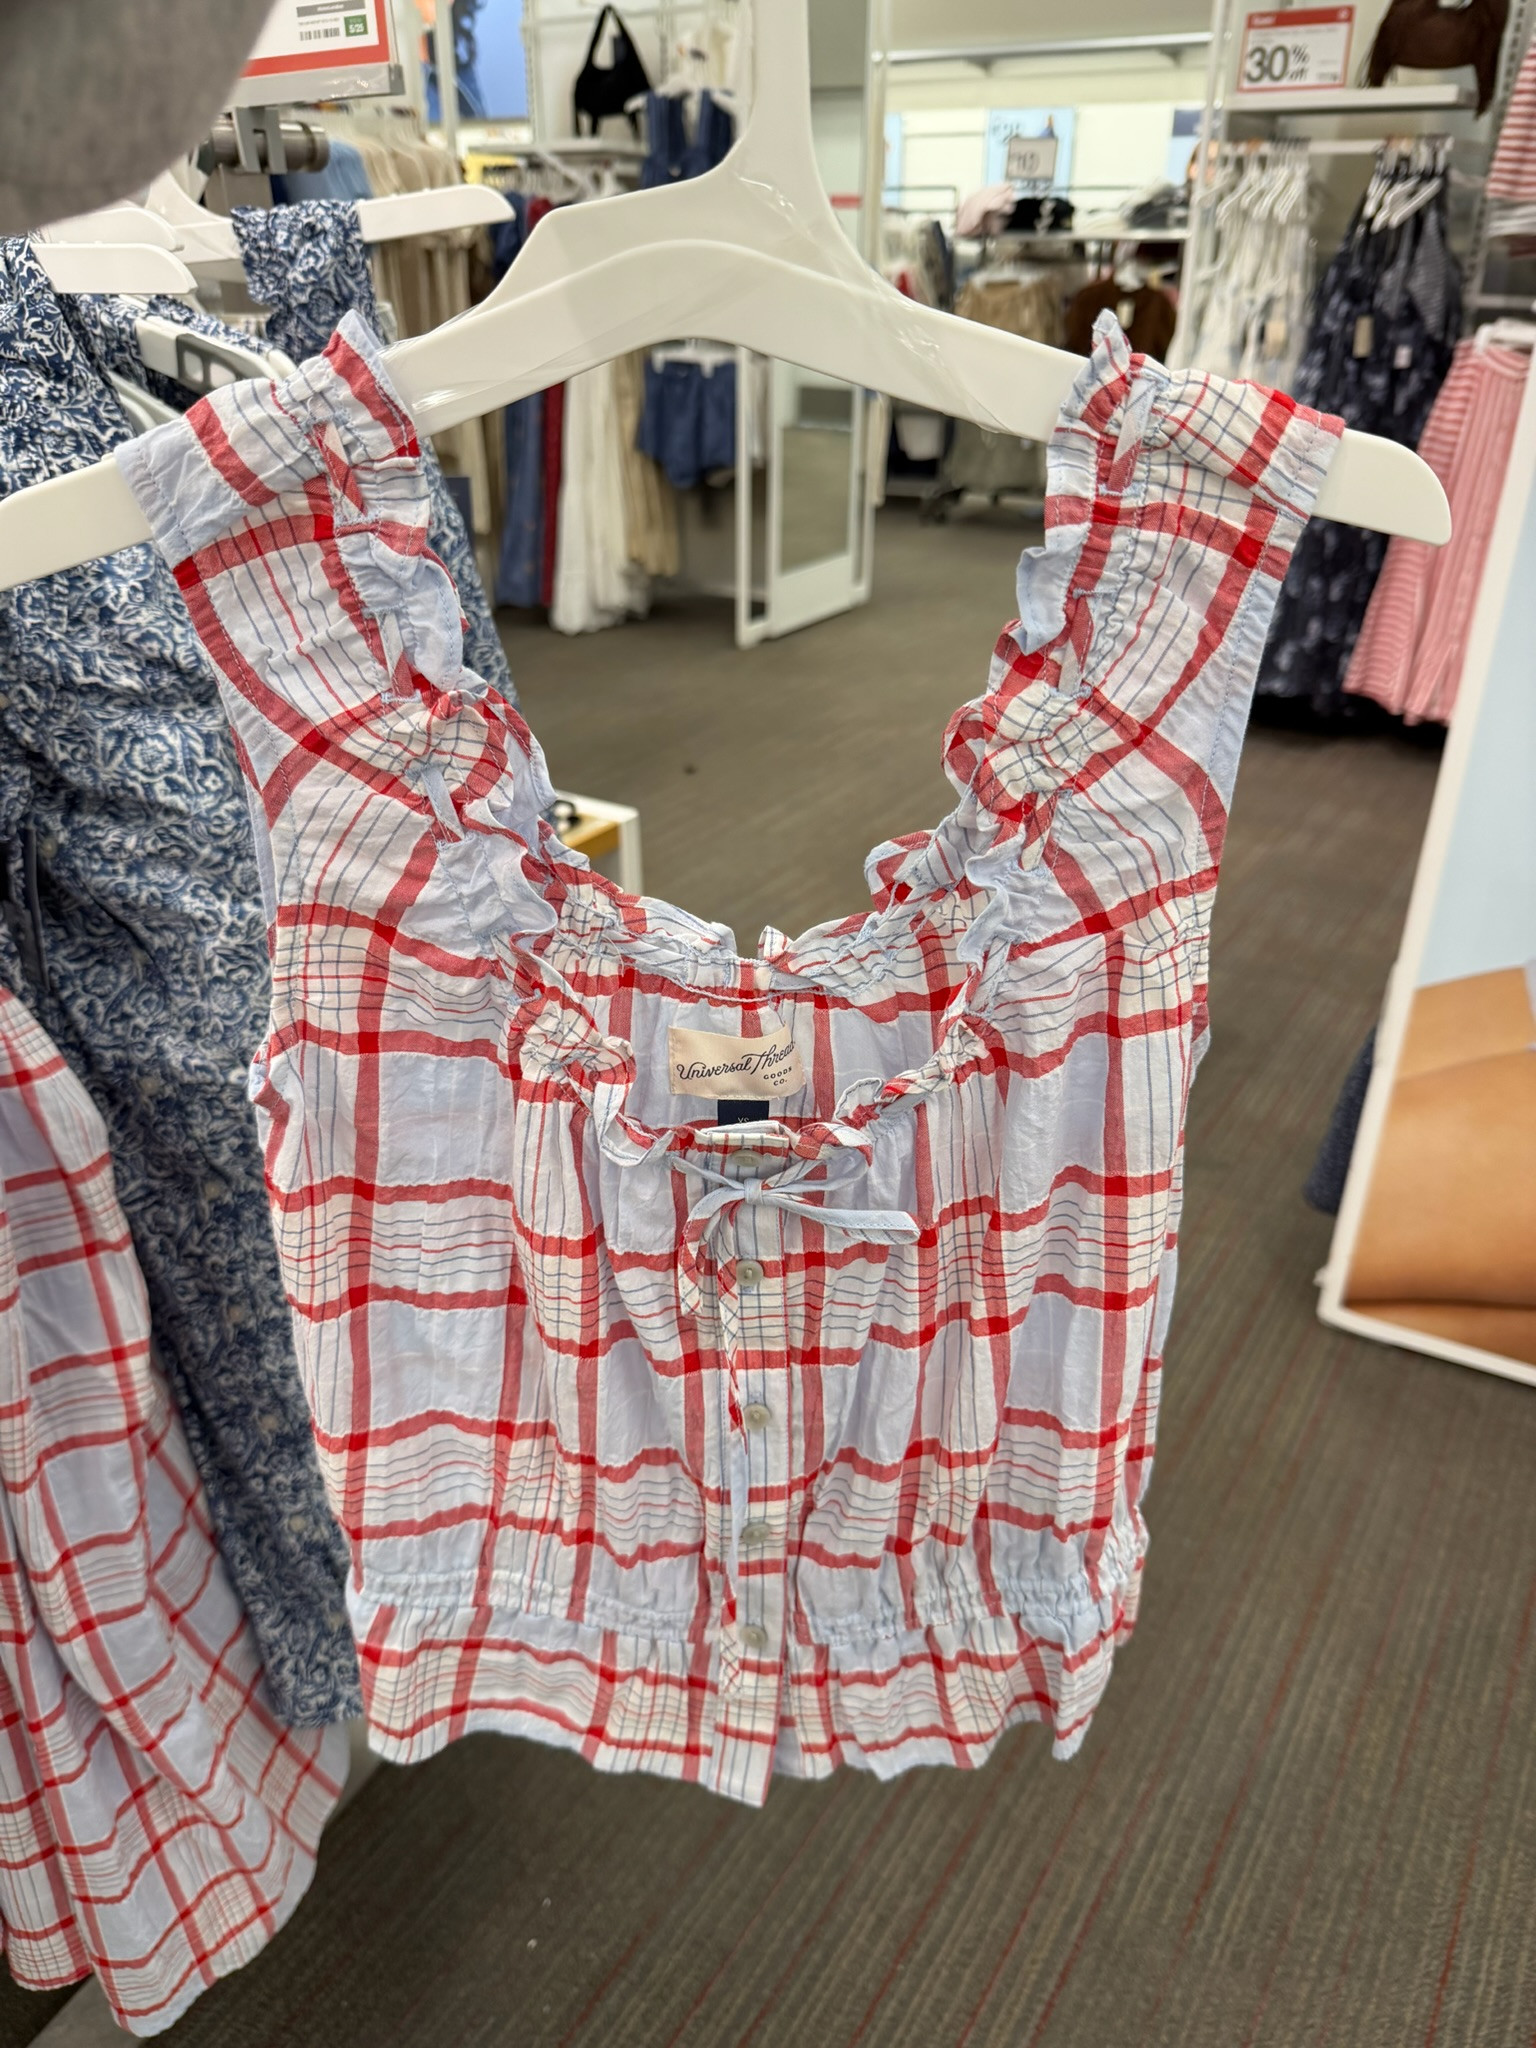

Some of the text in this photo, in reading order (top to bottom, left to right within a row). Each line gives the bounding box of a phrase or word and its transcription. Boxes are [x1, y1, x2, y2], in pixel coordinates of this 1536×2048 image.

[676, 1056, 752, 1080] Universal
[763, 1066, 792, 1080] GOODS
[773, 1078, 788, 1087] CO.
